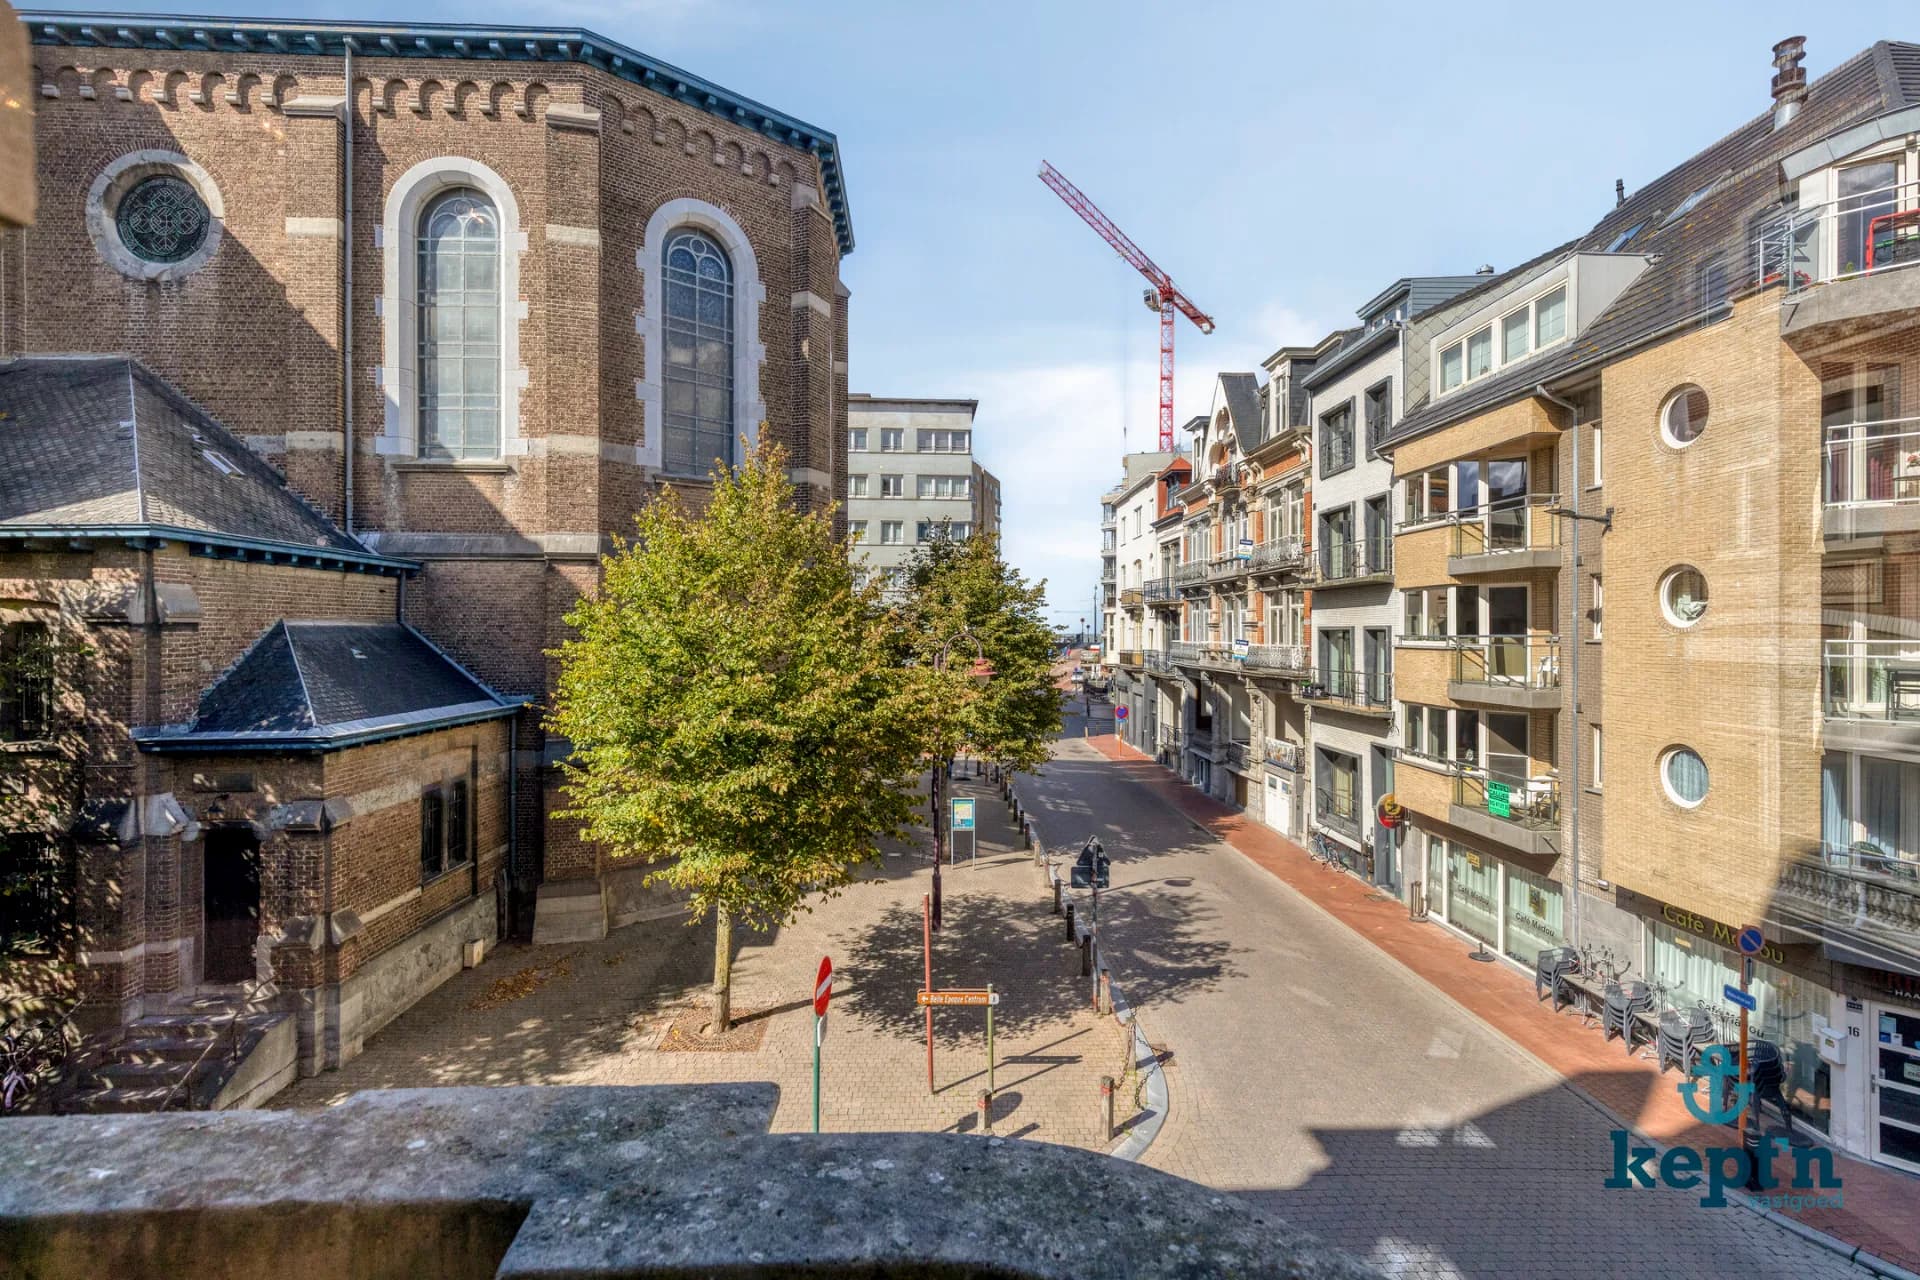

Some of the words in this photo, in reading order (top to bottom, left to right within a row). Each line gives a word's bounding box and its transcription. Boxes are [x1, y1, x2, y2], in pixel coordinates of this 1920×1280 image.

[1515, 912, 1531, 926] Café
[1532, 919, 1556, 938] Madou
[1663, 903, 1705, 933] Café
[1712, 922, 1785, 964] Mou
[1725, 1011, 1765, 1039] Maou
[1847, 1026, 1860, 1038] 16
